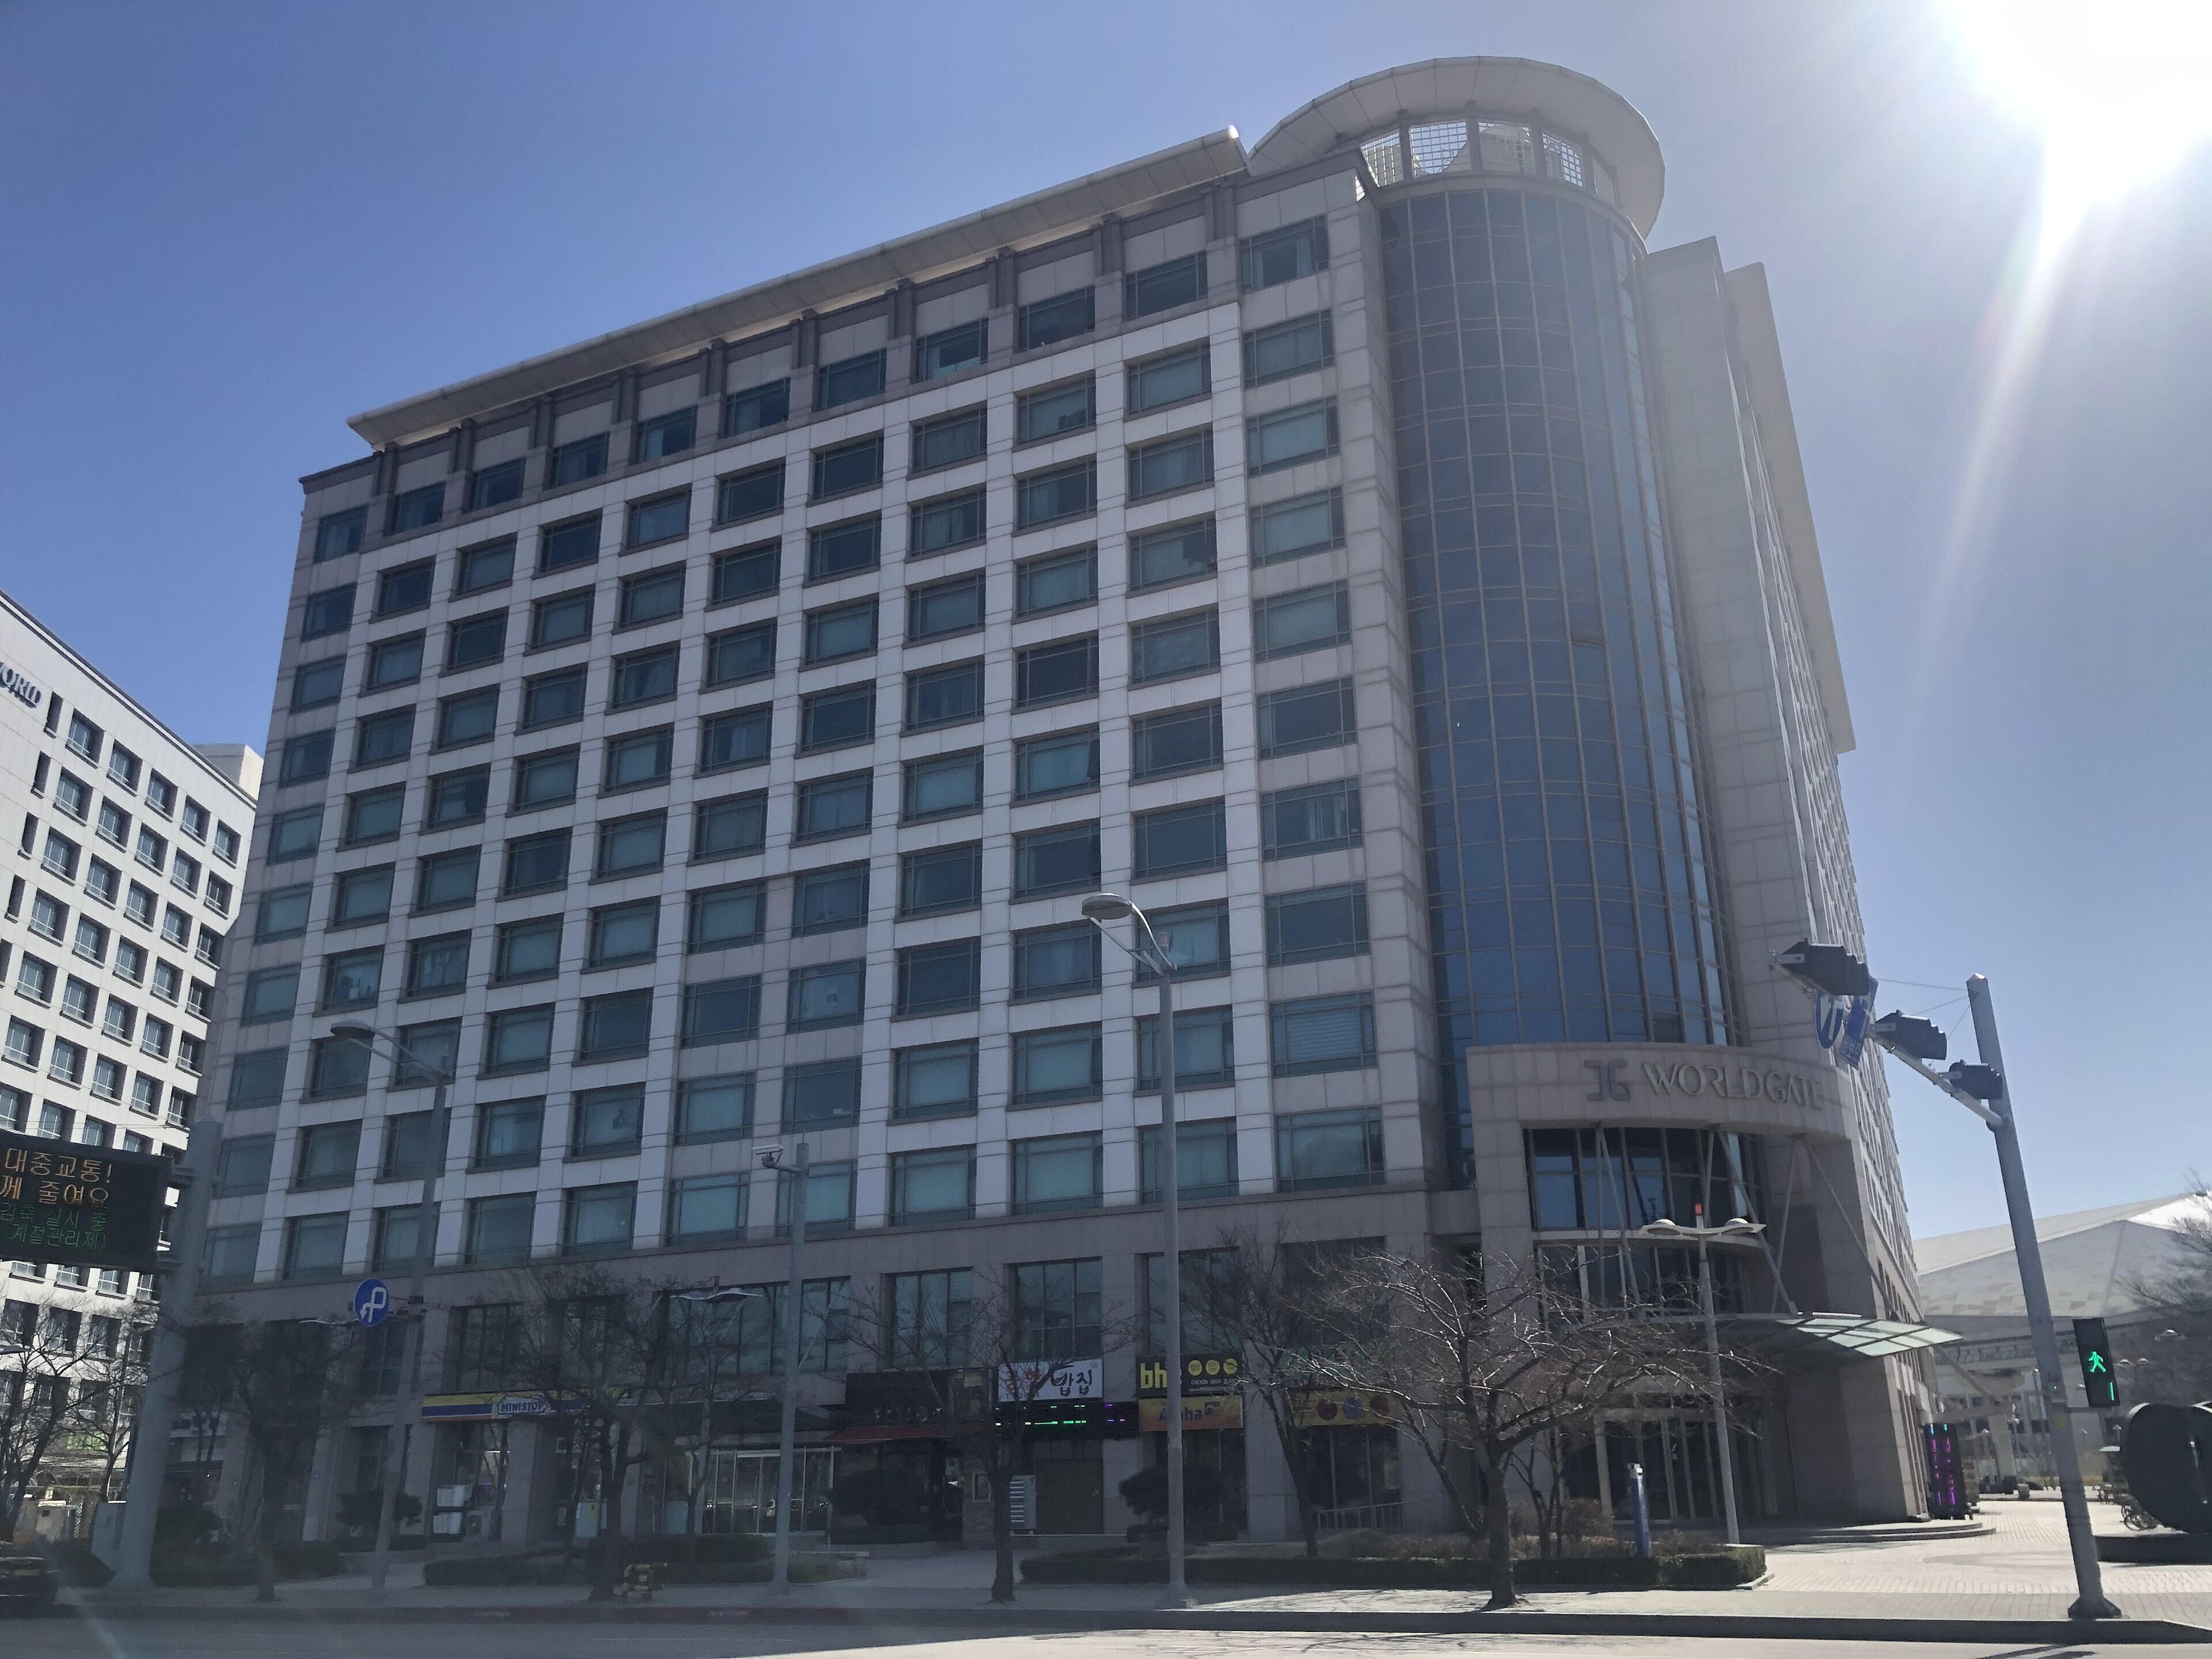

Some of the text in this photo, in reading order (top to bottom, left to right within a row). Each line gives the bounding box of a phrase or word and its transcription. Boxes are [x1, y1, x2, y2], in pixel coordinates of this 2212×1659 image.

[1643, 1063, 1823, 1110] WORLDGATE
[5, 1147, 112, 1183] 대중교통!
[38, 1180, 109, 1209] 줄여요
[46, 1207, 79, 1228] 실시
[91, 1212, 107, 1232] 중
[1050, 1369, 1093, 1396] 밥집
[501, 1401, 543, 1412] MINISTOP
